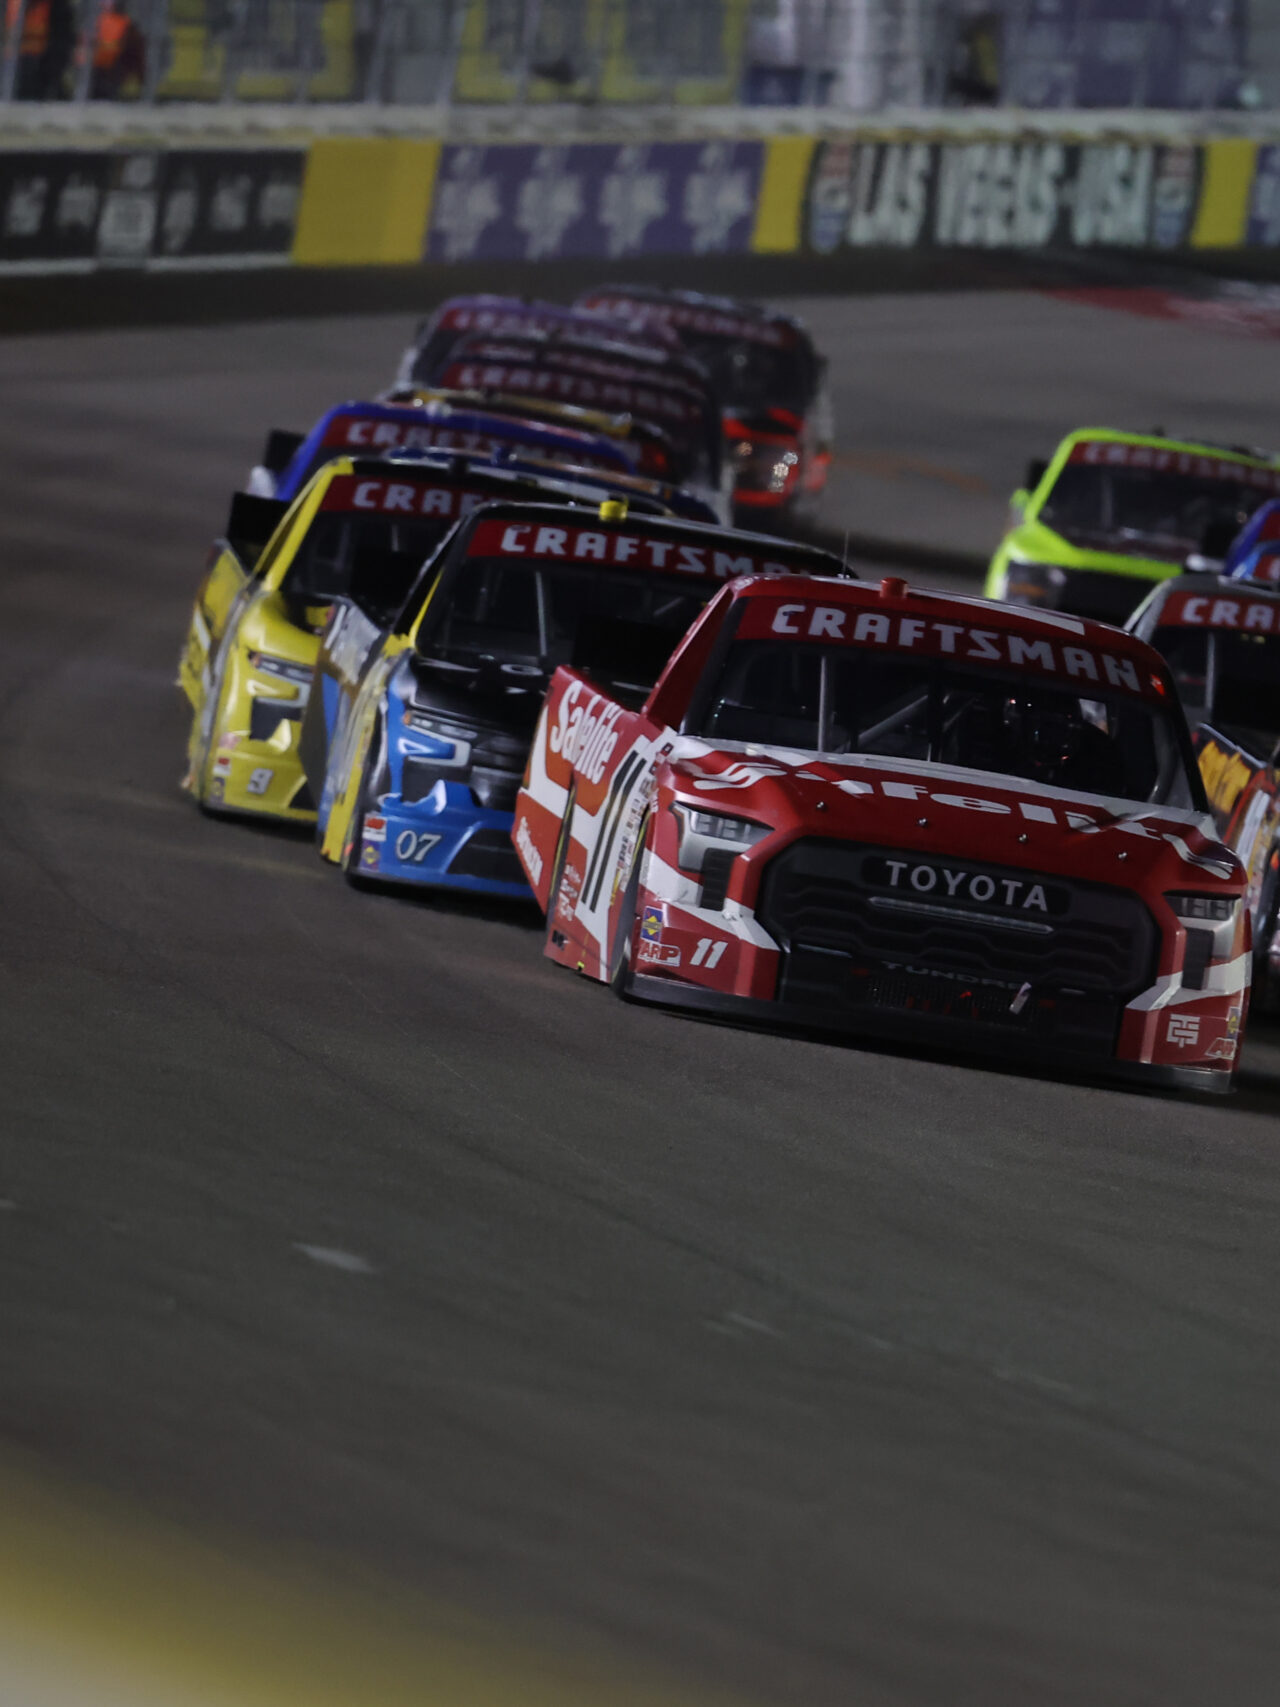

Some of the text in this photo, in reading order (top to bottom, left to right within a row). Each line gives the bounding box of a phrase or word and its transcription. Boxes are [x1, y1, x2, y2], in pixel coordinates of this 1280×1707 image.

[501, 524, 808, 577] CRAFTSM
[772, 603, 1142, 693] CRAFTSMAN
[247, 768, 274, 795] 9
[395, 829, 441, 862] 07
[884, 860, 1050, 913] TOYOTA
[689, 937, 729, 969] 11
